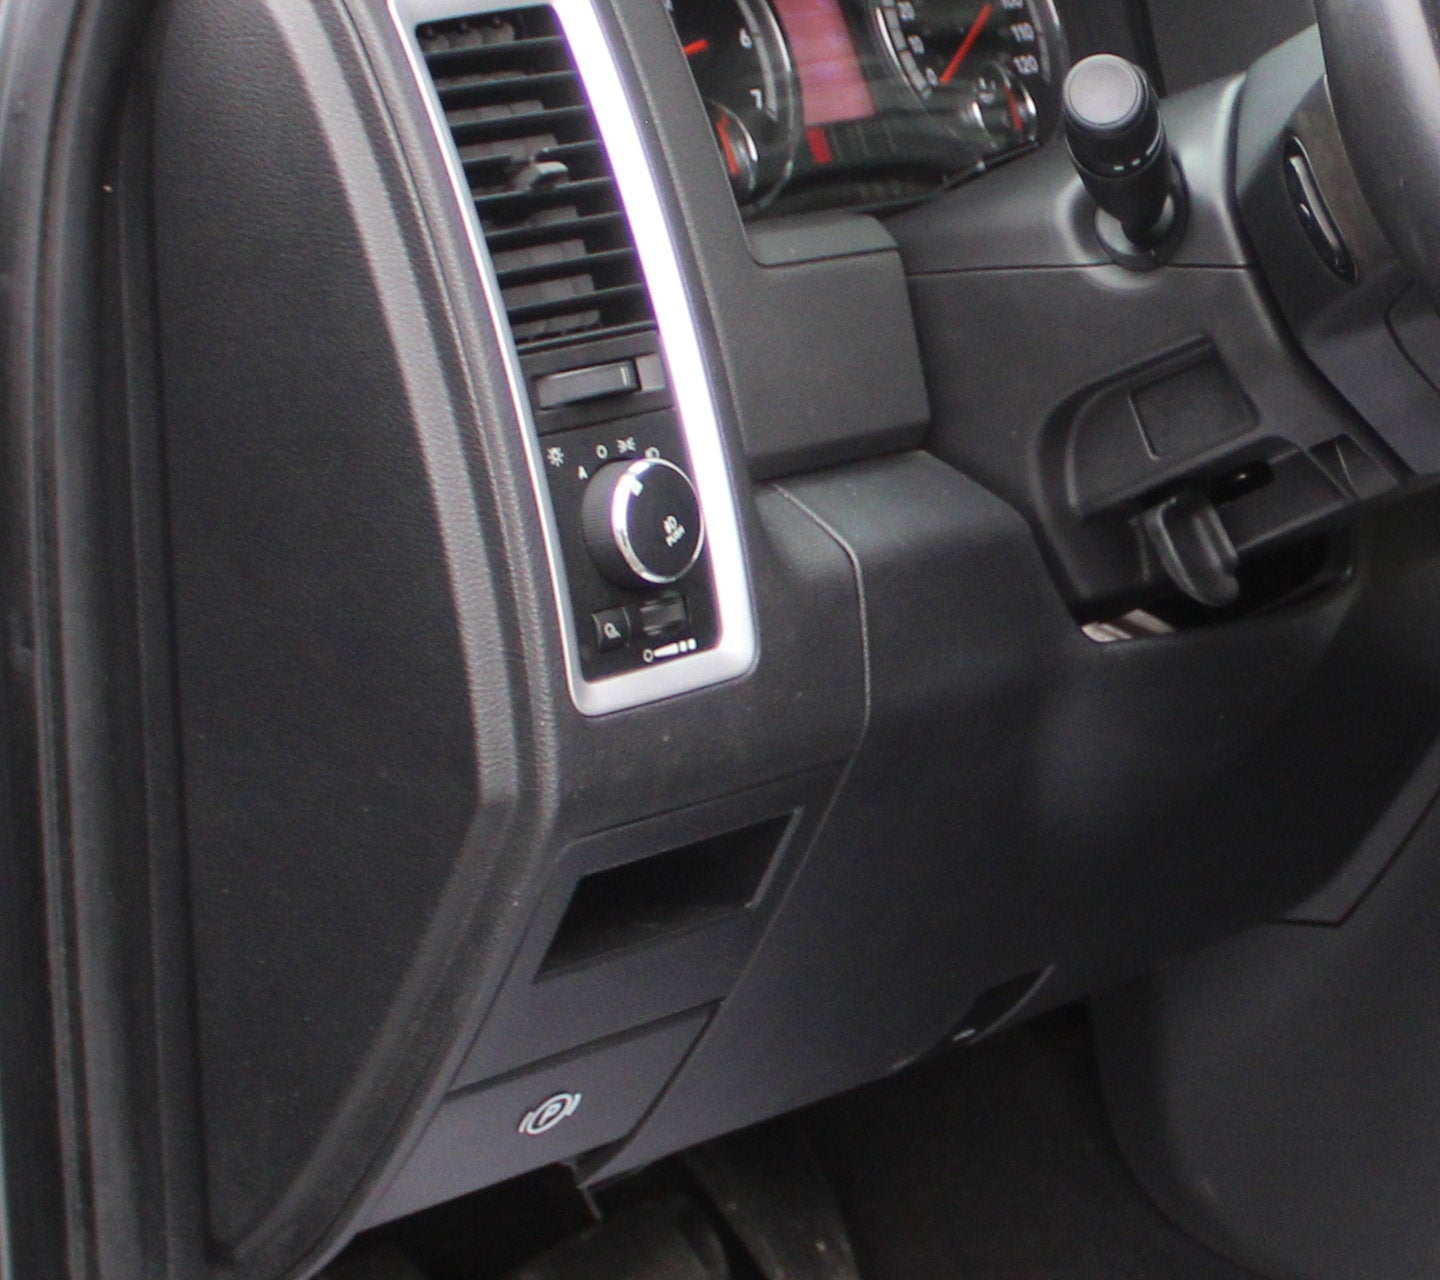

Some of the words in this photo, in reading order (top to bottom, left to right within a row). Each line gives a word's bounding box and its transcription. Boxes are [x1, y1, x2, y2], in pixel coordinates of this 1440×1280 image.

[738, 27, 753, 49] 6
[1010, 22, 1035, 42] 110
[907, 35, 925, 54] 10
[1012, 54, 1039, 75] 120
[749, 88, 764, 111] 7
[578, 465, 588, 480] A
